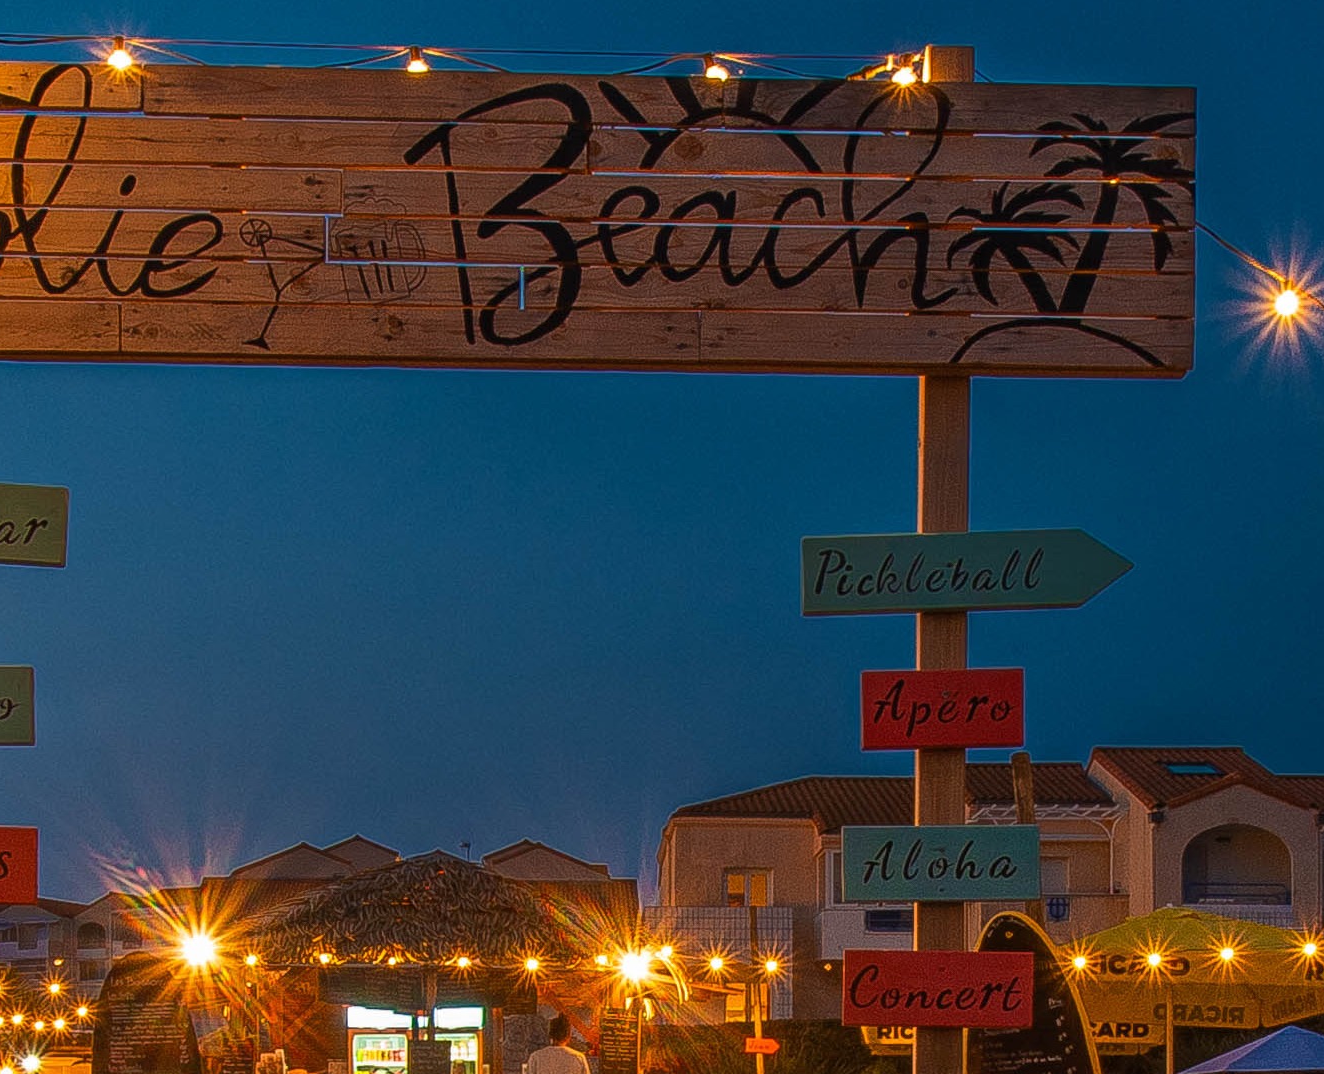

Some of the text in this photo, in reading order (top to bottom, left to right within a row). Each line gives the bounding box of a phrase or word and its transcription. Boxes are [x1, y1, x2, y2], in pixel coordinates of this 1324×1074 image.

[403, 82, 960, 346] Beach
[814, 547, 1045, 597] Pickleball
[873, 678, 1016, 739] Apéro
[862, 838, 1018, 884] Aloha
[848, 963, 1024, 1012] Concert
